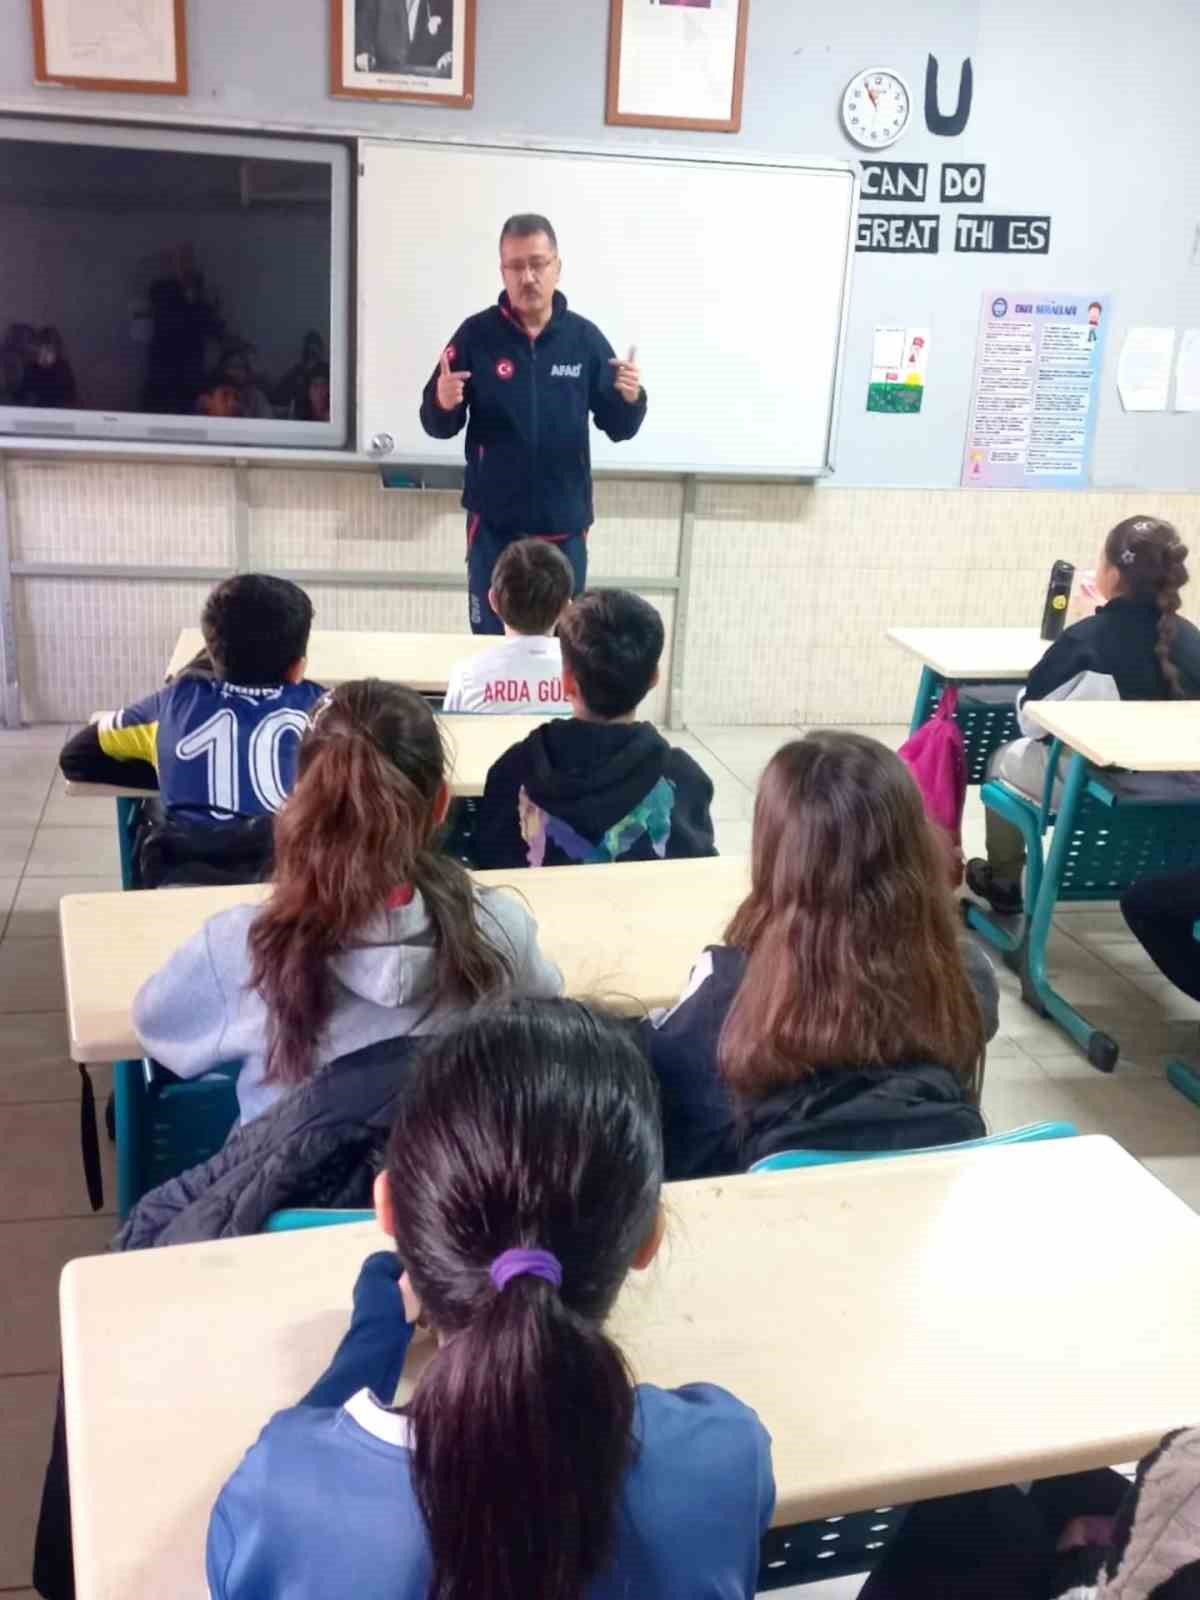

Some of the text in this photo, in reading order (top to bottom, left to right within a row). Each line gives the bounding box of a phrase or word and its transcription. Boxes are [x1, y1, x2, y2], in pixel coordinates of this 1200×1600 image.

[924, 52, 973, 137] U
[861, 166, 982, 197] CAN DO
[855, 217, 937, 249] GREAT
[550, 363, 582, 377] AFAD
[483, 679, 530, 702] ARDA
[175, 707, 311, 820] 10
